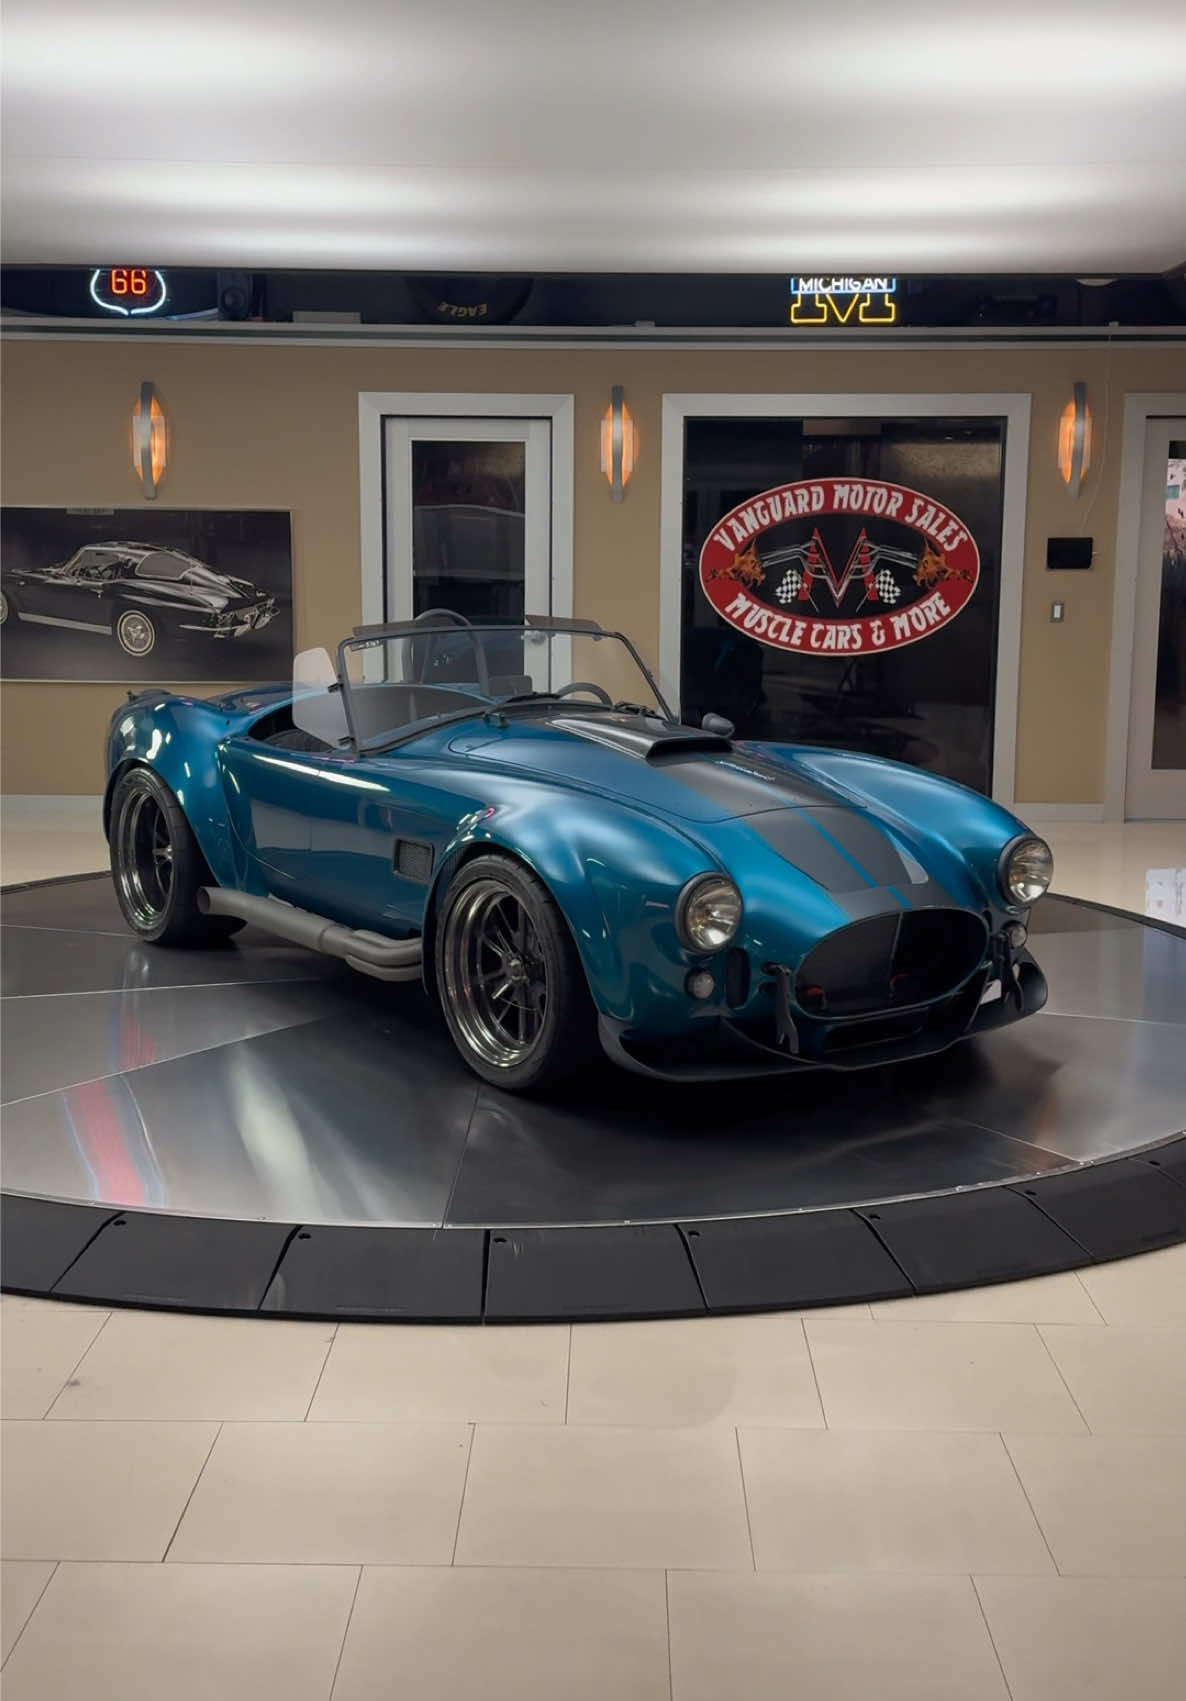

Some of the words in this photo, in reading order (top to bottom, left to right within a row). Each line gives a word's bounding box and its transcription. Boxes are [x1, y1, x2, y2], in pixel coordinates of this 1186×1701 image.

[111, 268, 147, 294] 66
[798, 277, 888, 292] MICHIGAN
[713, 485, 825, 552] VANGUARD
[833, 483, 904, 517] MOTOR
[905, 498, 969, 552] SALES
[724, 592, 808, 646] MUSCLE
[809, 622, 862, 651] CARS
[871, 620, 886, 647] &
[890, 591, 951, 641] MORE
